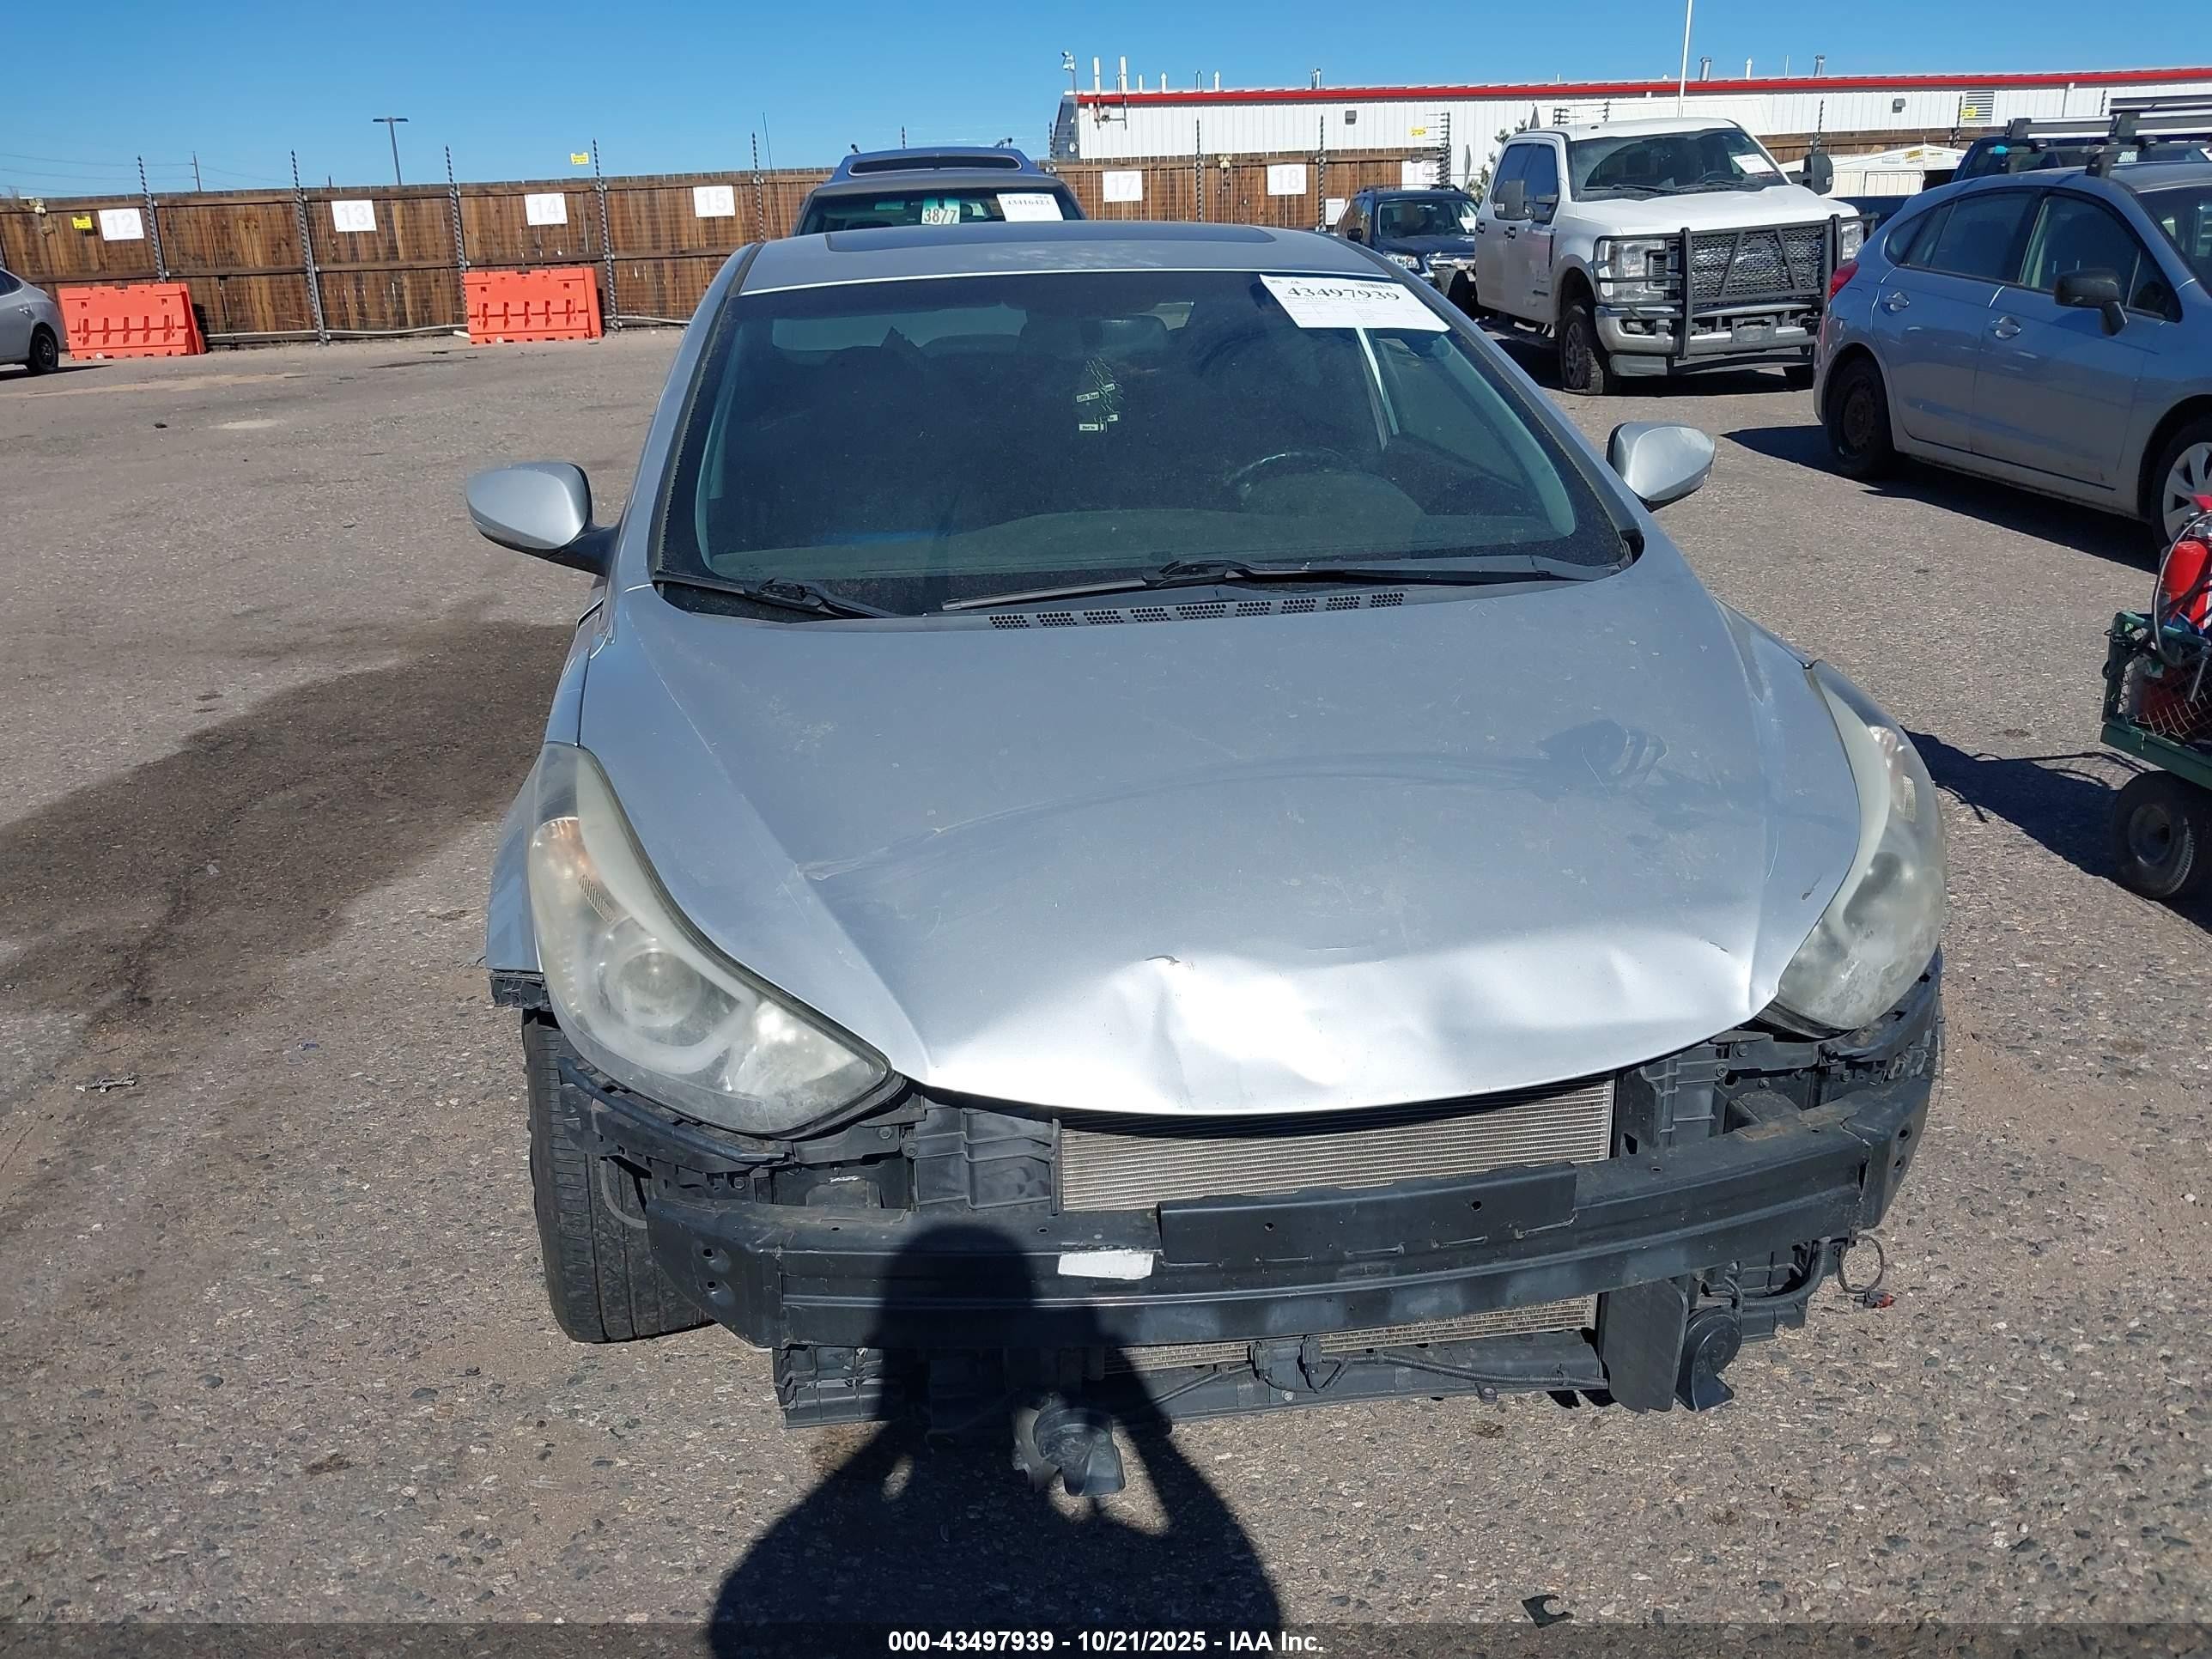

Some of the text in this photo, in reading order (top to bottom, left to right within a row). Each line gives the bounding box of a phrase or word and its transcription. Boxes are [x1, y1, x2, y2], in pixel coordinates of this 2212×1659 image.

[1109, 174, 1136, 196] 17
[1275, 169, 1300, 189] 18
[533, 198, 562, 219] 14
[702, 190, 728, 211] 15
[106, 212, 137, 234] 12
[340, 204, 368, 226] 13
[924, 208, 957, 224] 3877
[1287, 287, 1400, 301] 43497939
